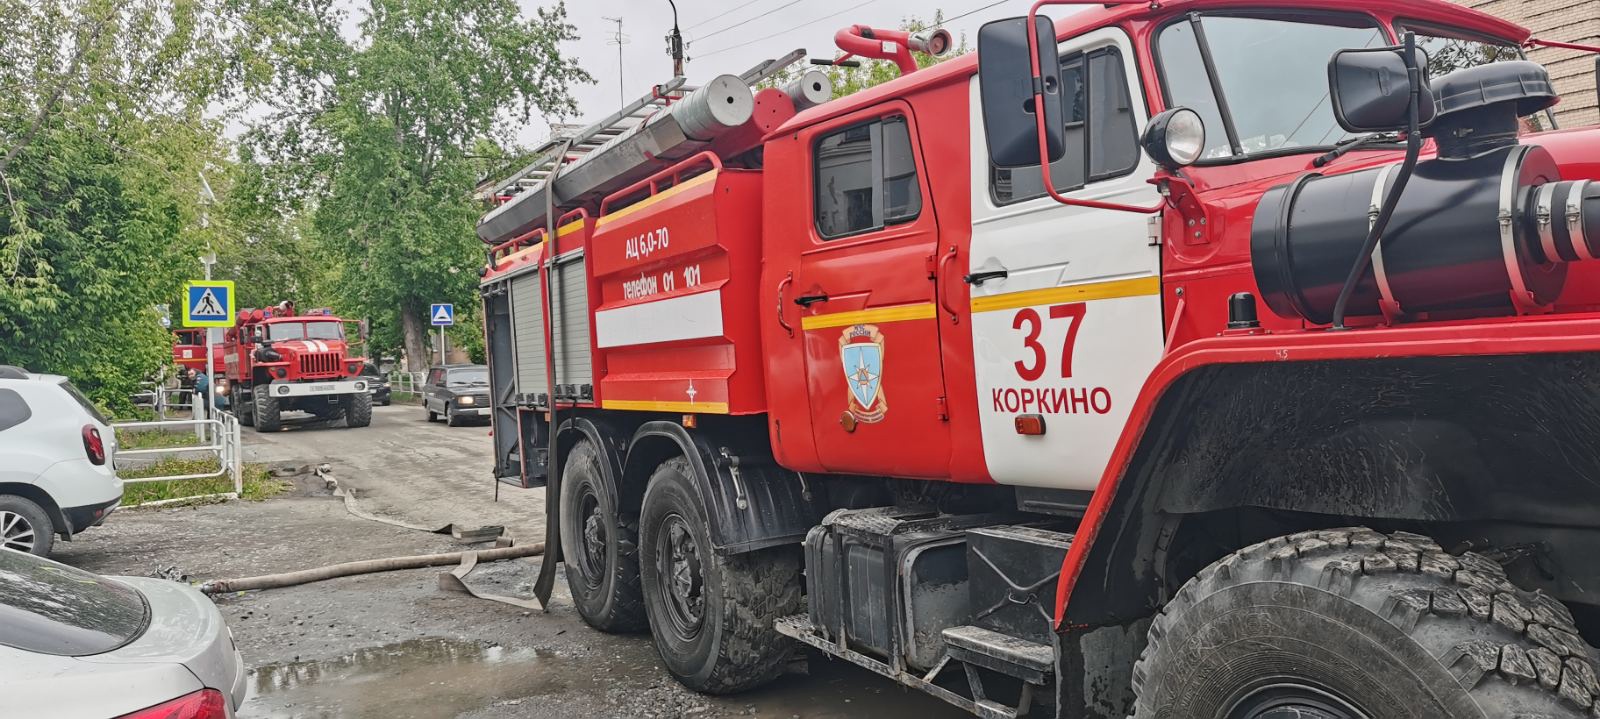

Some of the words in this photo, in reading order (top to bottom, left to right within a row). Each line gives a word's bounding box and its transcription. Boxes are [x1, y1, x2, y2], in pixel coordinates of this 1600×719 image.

[626, 236, 640, 260] АЦ
[640, 226, 669, 257] 6,0-70
[623, 271, 658, 300] телефон
[663, 270, 675, 292] 01
[683, 264, 701, 288] 101
[1012, 302, 1087, 381] 37
[992, 387, 1112, 415] КОРКИНО
